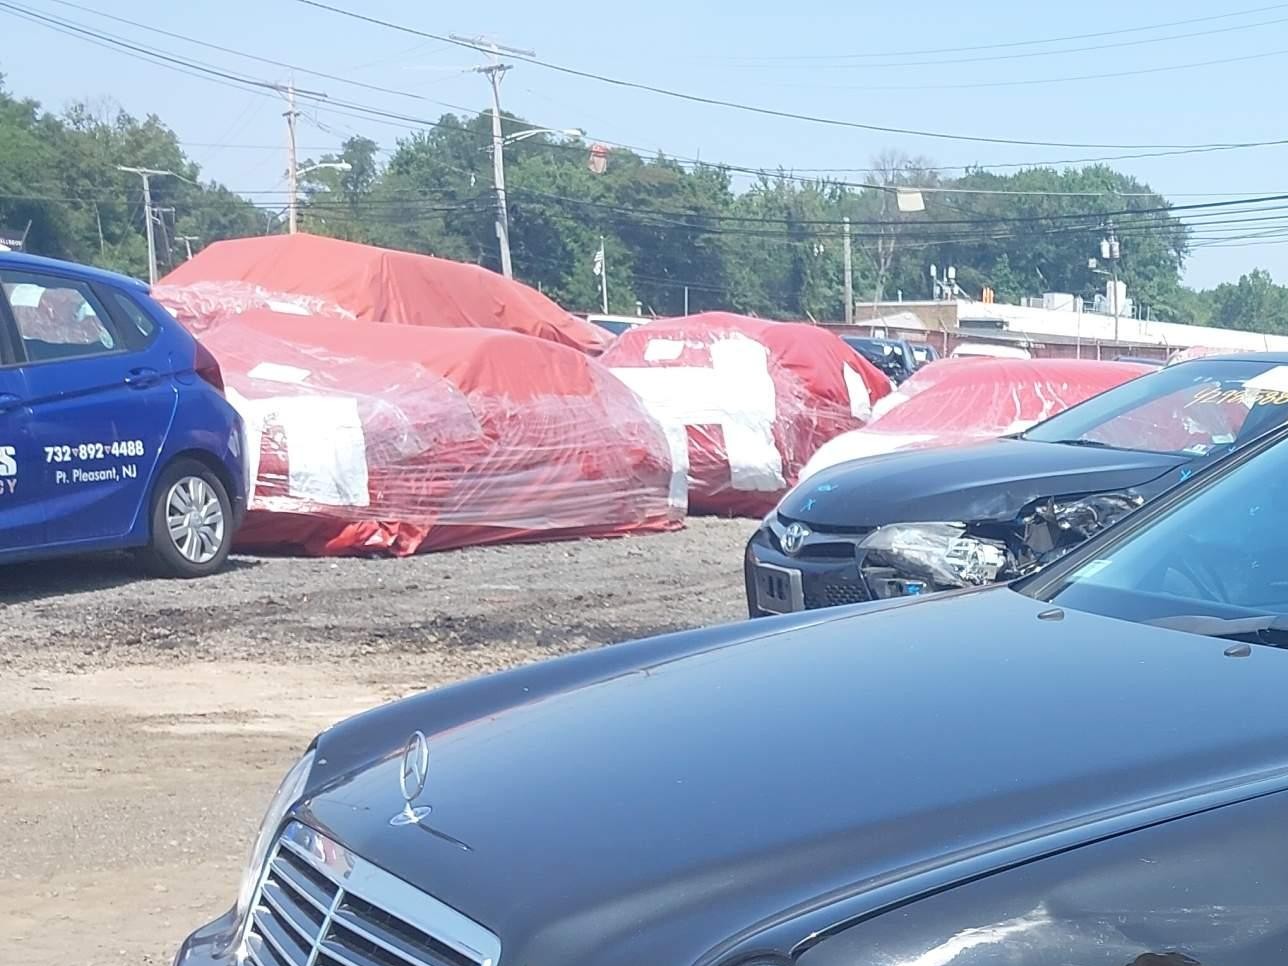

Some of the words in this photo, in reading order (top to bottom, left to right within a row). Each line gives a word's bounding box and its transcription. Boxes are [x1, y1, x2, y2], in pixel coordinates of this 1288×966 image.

[56, 470, 70, 484] Pt.
[72, 467, 119, 482] Pleasant,
[122, 464, 137, 478] NJ
